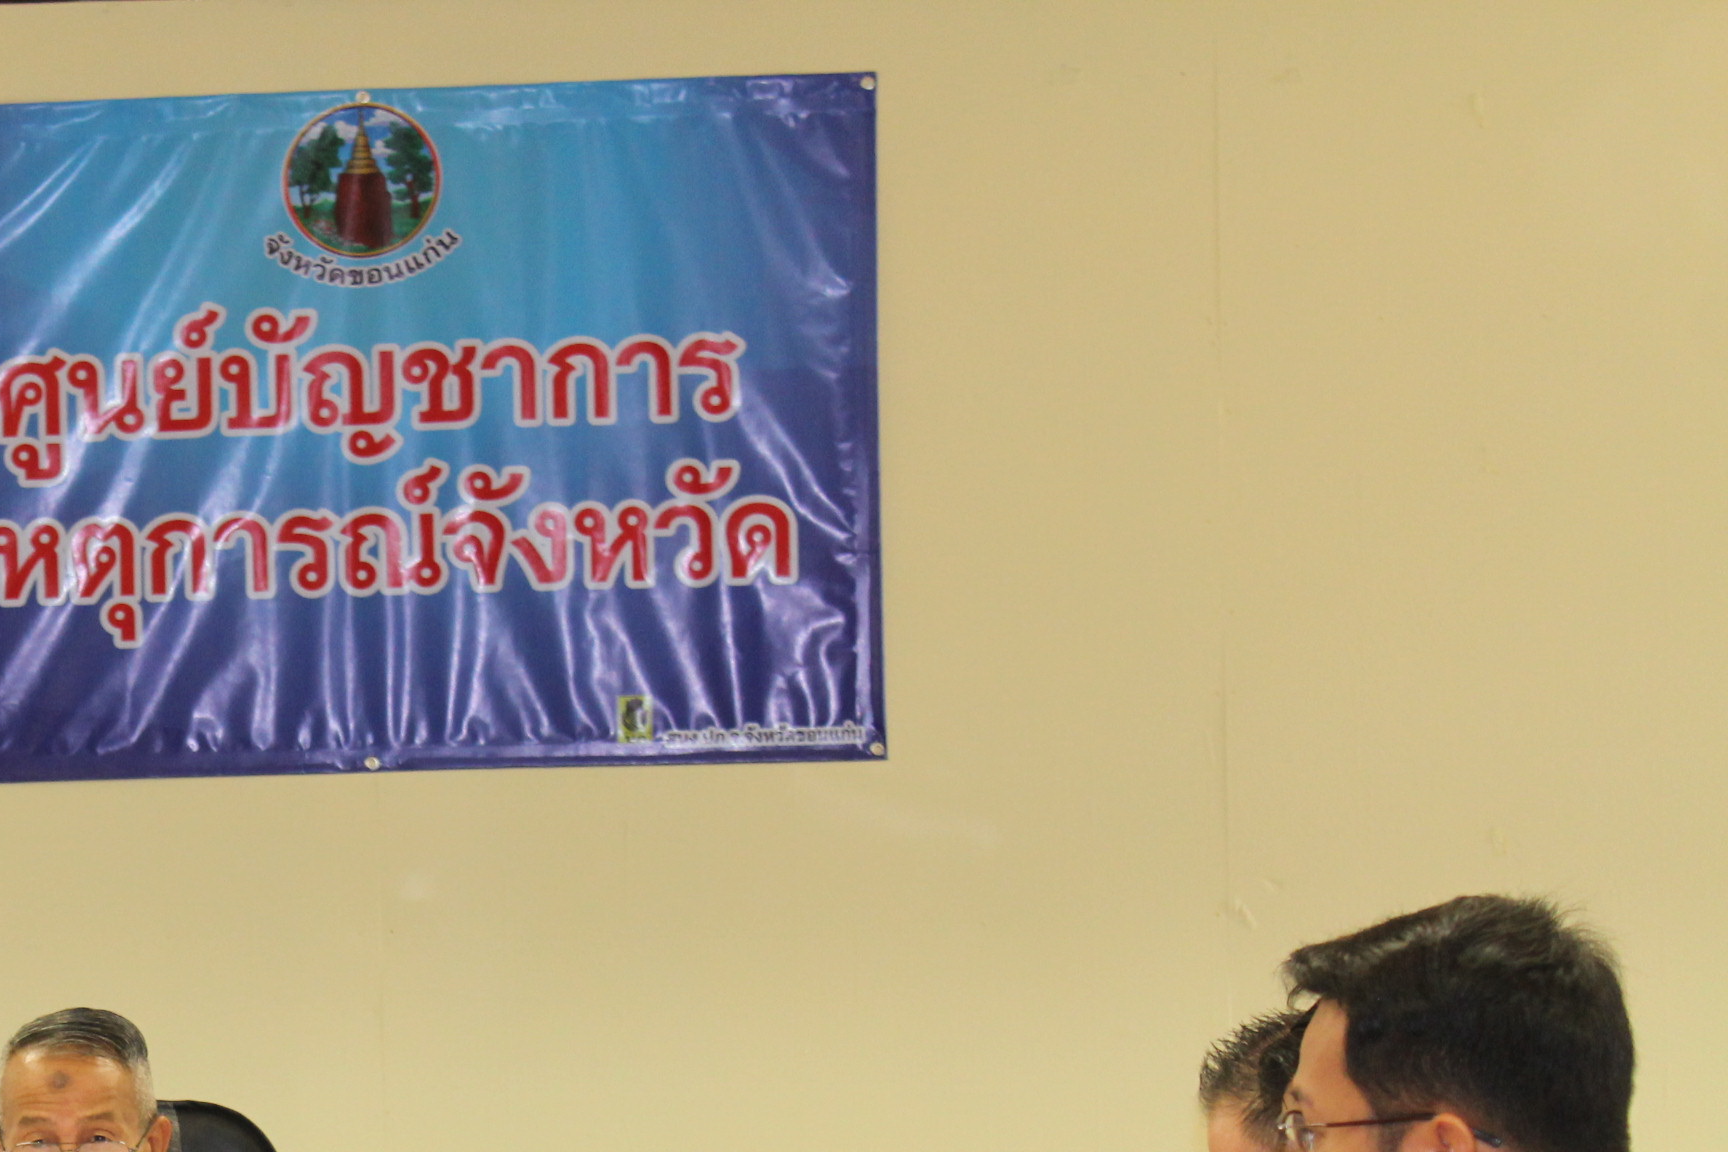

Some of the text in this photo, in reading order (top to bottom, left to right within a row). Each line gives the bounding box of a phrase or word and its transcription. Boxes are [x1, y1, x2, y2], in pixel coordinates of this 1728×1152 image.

[265, 230, 460, 287] จังหวัดขอนแก่น
